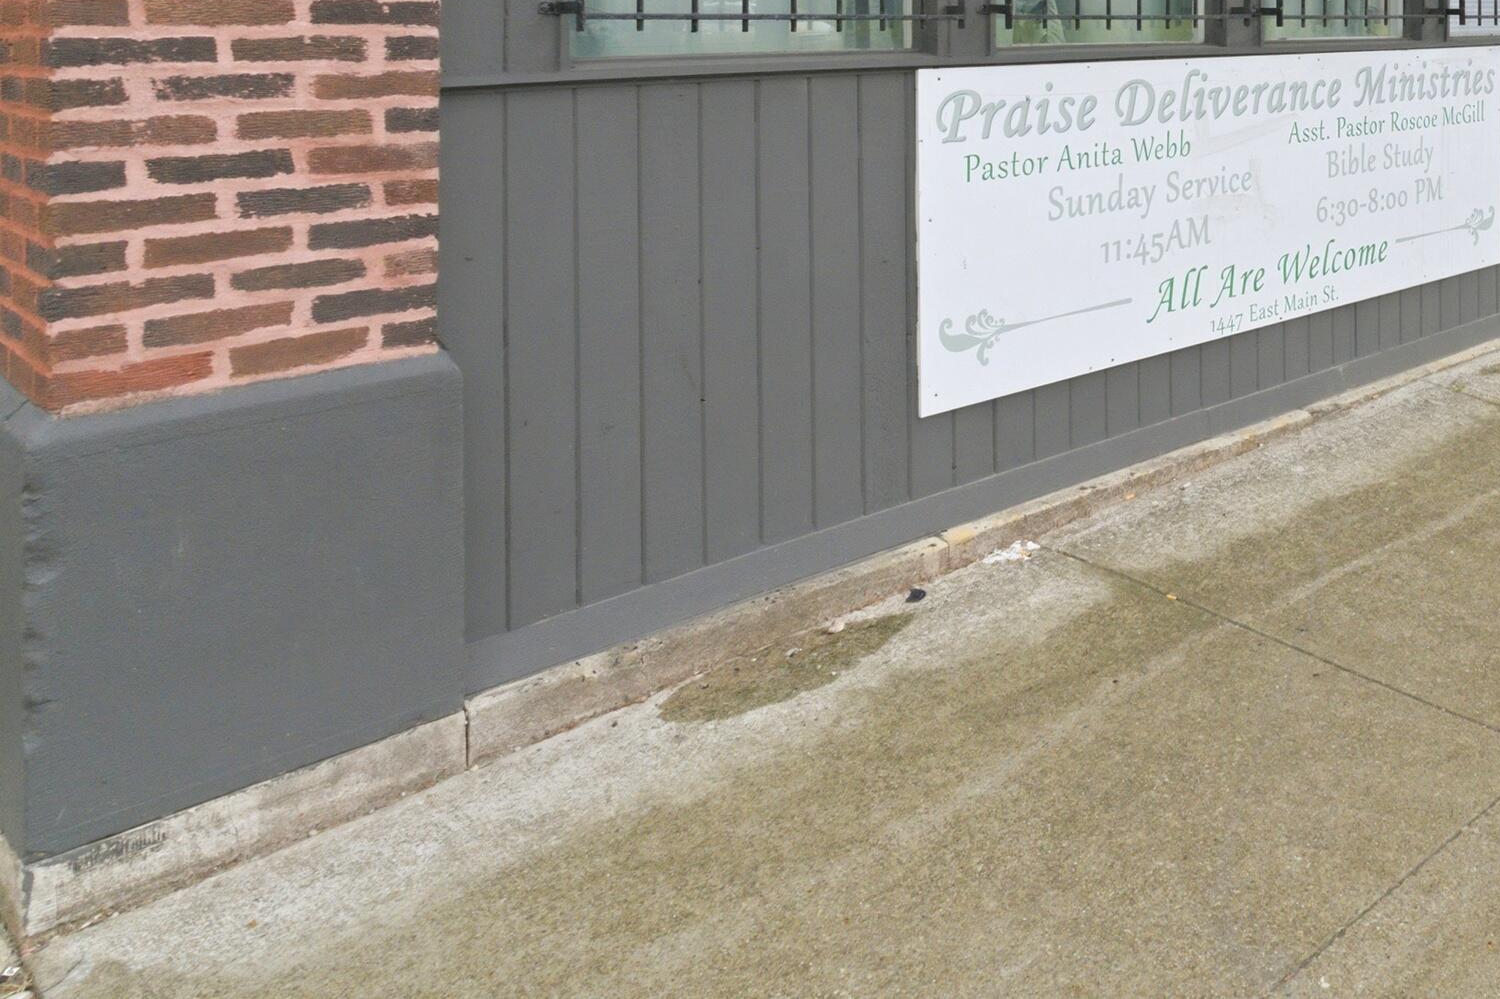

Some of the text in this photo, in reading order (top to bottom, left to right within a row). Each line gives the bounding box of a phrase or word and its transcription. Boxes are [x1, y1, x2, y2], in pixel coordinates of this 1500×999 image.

[935, 57, 1496, 144] Praise Deliverance Ministries
[1288, 100, 1485, 145] Asst. Pastor Roscoe McGill
[963, 129, 1191, 183] Pastor Anita Webb
[1326, 135, 1434, 179] Bible Study
[1047, 165, 1253, 222] Sunday Service
[1316, 175, 1443, 227] 6:30-8:00 PM
[1100, 214, 1212, 266] 11:45AM
[1146, 238, 1389, 324] All Are Welcome
[1209, 284, 1339, 335] 1447 East Main St.
